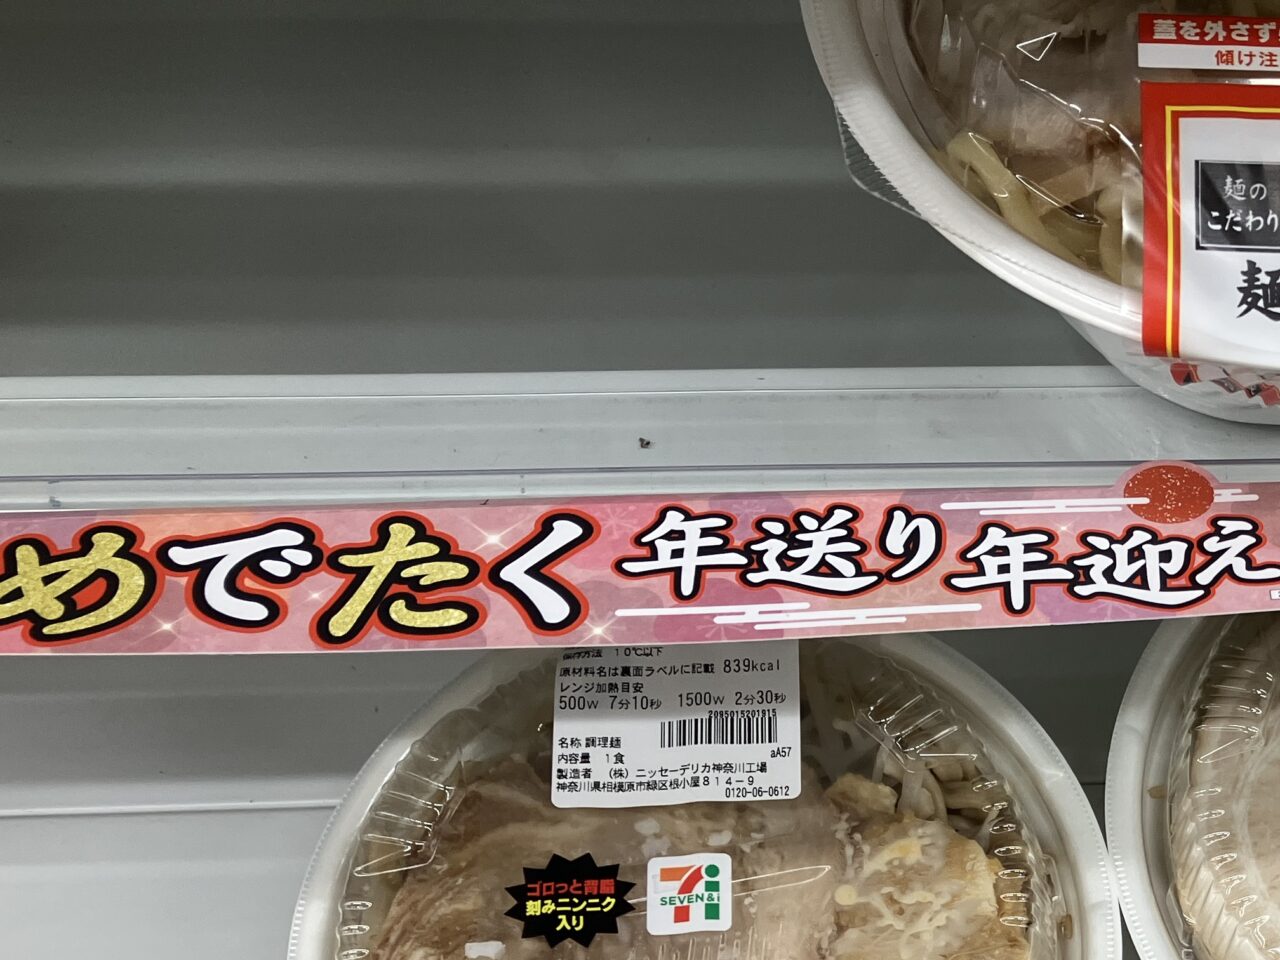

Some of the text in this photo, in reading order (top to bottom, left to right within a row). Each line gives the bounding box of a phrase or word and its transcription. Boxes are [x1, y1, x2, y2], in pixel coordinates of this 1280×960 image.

[1224, 175, 1267, 201] 麺の
[1207, 210, 1279, 233] こだわり
[0, 513, 592, 643] めでたく
[616, 504, 946, 597] 年送り
[560, 658, 780, 678] 原材料名は裏面ラベルに記載 839kcal
[560, 682, 644, 693] レンジ加熱目安
[609, 695, 662, 710] 7分10秒
[735, 690, 786, 705] 2分30秒
[558, 737, 622, 749] 名称 調理麺
[558, 752, 625, 764] 内容量 1食
[770, 747, 792, 758] aA57
[557, 768, 592, 779] 製造者
[635, 762, 767, 778] ニッセーデリカ神奈川工場
[725, 786, 790, 798] 0120-06-0612
[527, 878, 615, 897] ゴロっと背脂
[525, 897, 616, 917] 刻みニンニク
[555, 914, 585, 932] 入り
